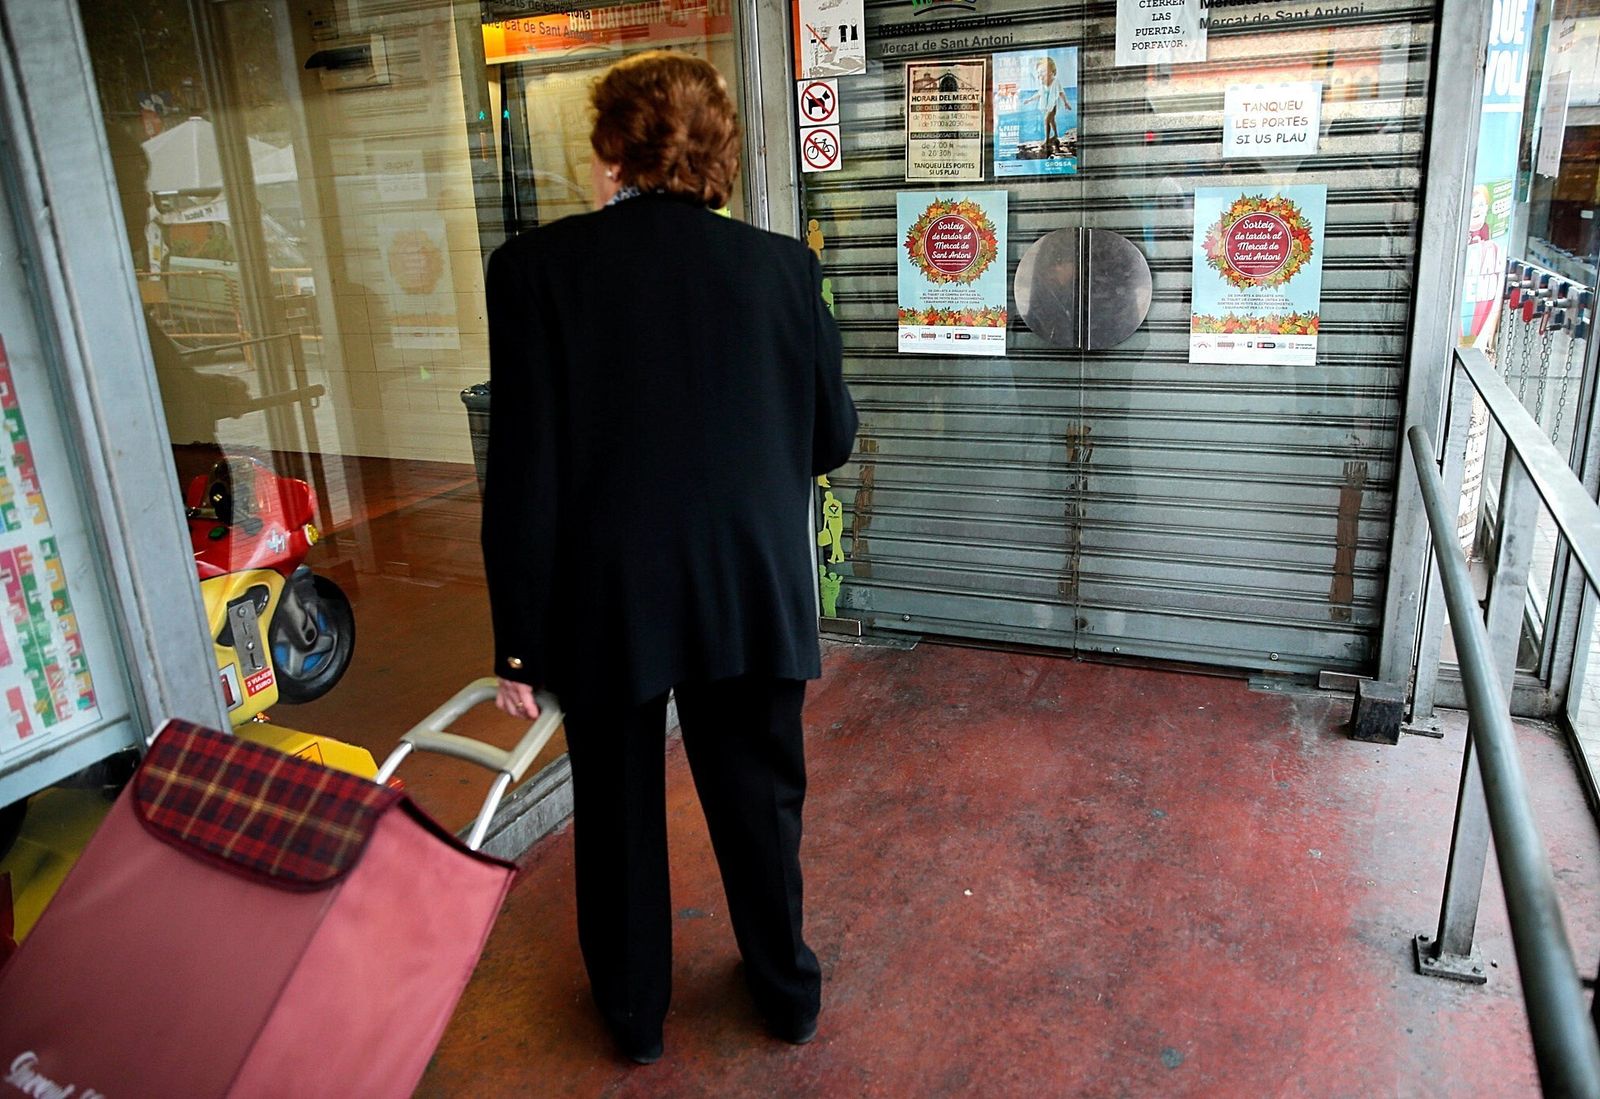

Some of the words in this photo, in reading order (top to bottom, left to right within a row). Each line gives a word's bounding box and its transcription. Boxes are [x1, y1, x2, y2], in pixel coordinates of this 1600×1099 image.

[1138, 0, 1185, 9] CIERREN
[569, 10, 594, 32] BAR
[1151, 12, 1172, 21] LAS
[1199, 14, 1248, 29] Mercat
[1252, 13, 1270, 23] de
[1275, 8, 1309, 21] Sant
[1313, 3, 1364, 18] Antoni
[523, 21, 536, 33] de
[538, 22, 561, 36] Sant
[1135, 26, 1185, 37] PUERTAS,
[880, 40, 919, 53] Mercat
[922, 40, 937, 50] de
[940, 37, 968, 49] Sant
[972, 32, 1014, 47] Antoni
[1131, 40, 1188, 51] PORFAVOR.
[1242, 100, 1303, 112] TANQUEU
[1235, 118, 1256, 129] LES
[1262, 116, 1308, 128] PORTES
[1236, 134, 1250, 144] SI
[1255, 134, 1272, 144] US
[1276, 132, 1307, 143] PLAU
[938, 221, 964, 232] Sorteig
[1243, 220, 1275, 231] Sorteig
[932, 232, 940, 240] de
[941, 232, 962, 240] tardor
[1235, 232, 1245, 240] de
[1246, 232, 1271, 240] tardor
[1272, 231, 1282, 240] al
[1237, 241, 1268, 251] Mercat
[1269, 242, 1279, 250] de
[1233, 252, 1252, 261] Sant
[1253, 252, 1281, 261] Antoni
